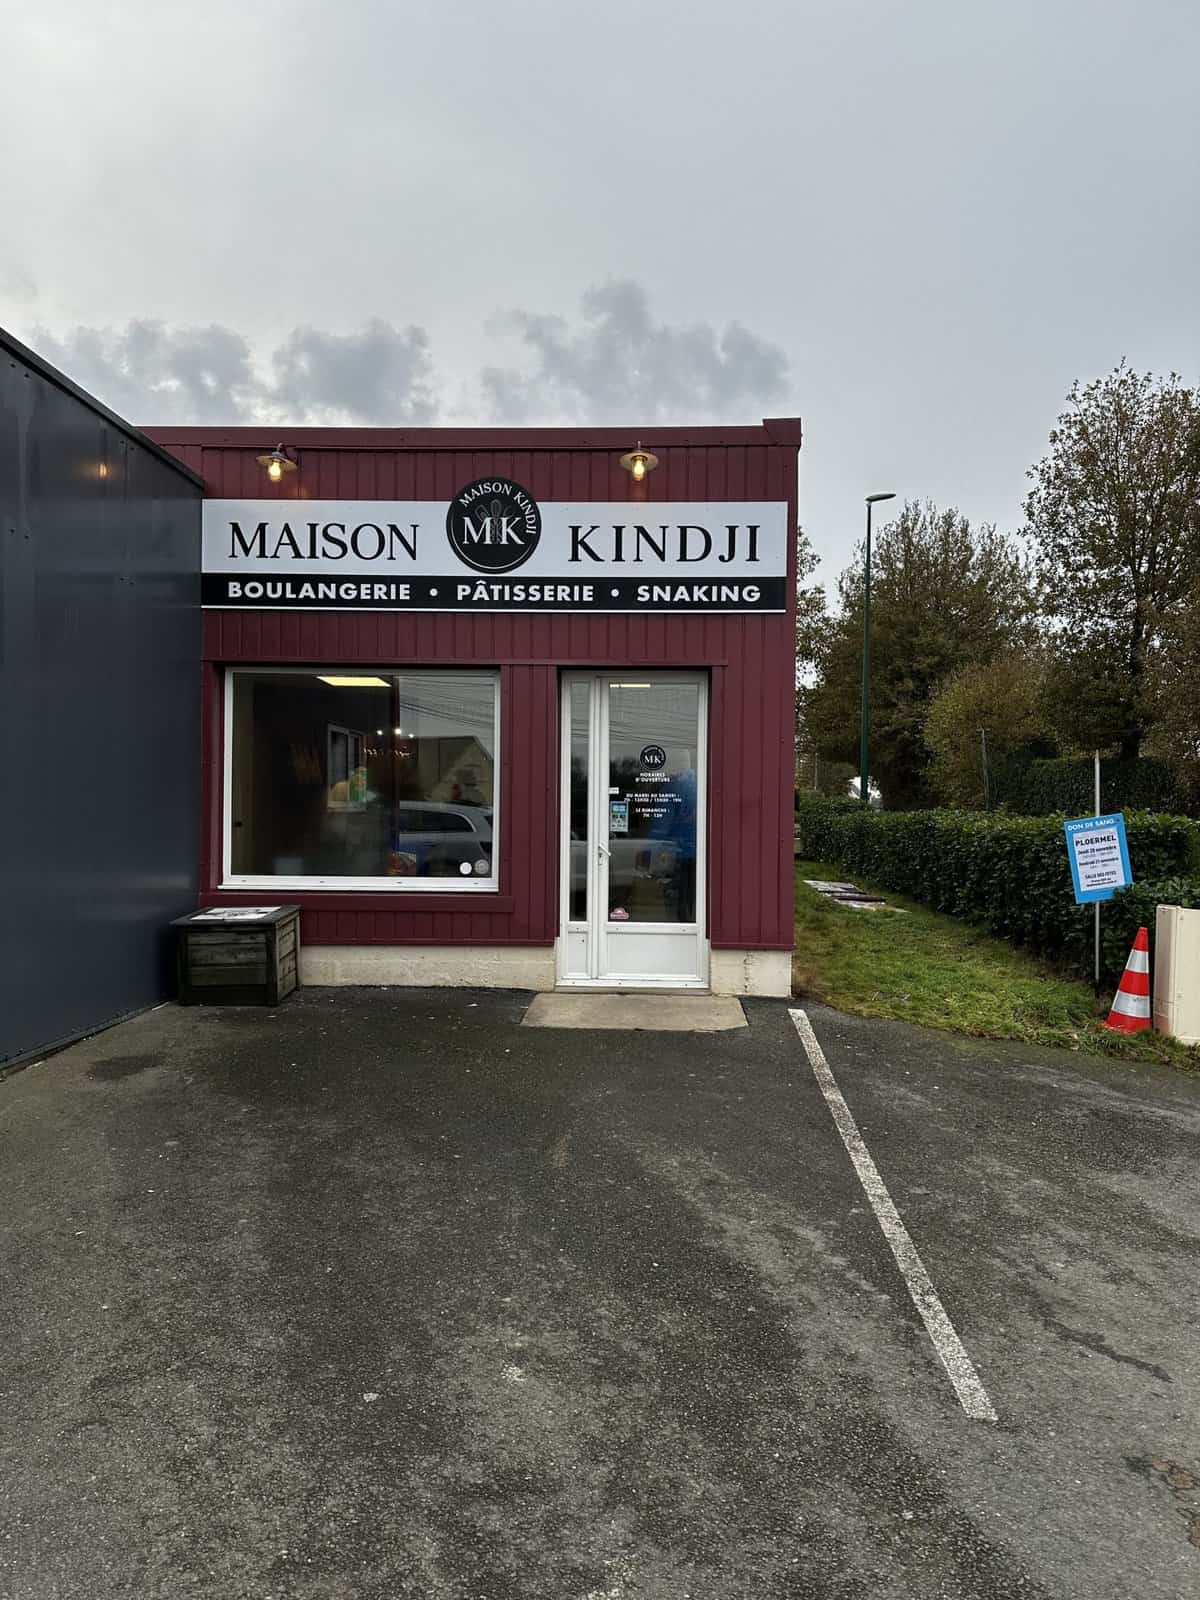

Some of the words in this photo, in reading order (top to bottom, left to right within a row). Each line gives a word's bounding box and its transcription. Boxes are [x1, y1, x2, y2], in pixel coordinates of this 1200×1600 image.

[459, 482, 512, 507] MAISON
[513, 491, 537, 535] KINDJI
[229, 522, 419, 560] MAISON
[568, 525, 760, 562] KINDJI
[462, 516, 526, 545] MK
[228, 581, 411, 600] BOULANGERIE
[457, 579, 594, 602] PÂTISSERIE
[636, 585, 761, 602] SNAKING
[644, 754, 661, 764] MK
[1067, 823, 1084, 831] DON
[1095, 818, 1115, 826] SANG
[1075, 835, 1117, 847] PLOERMEL
